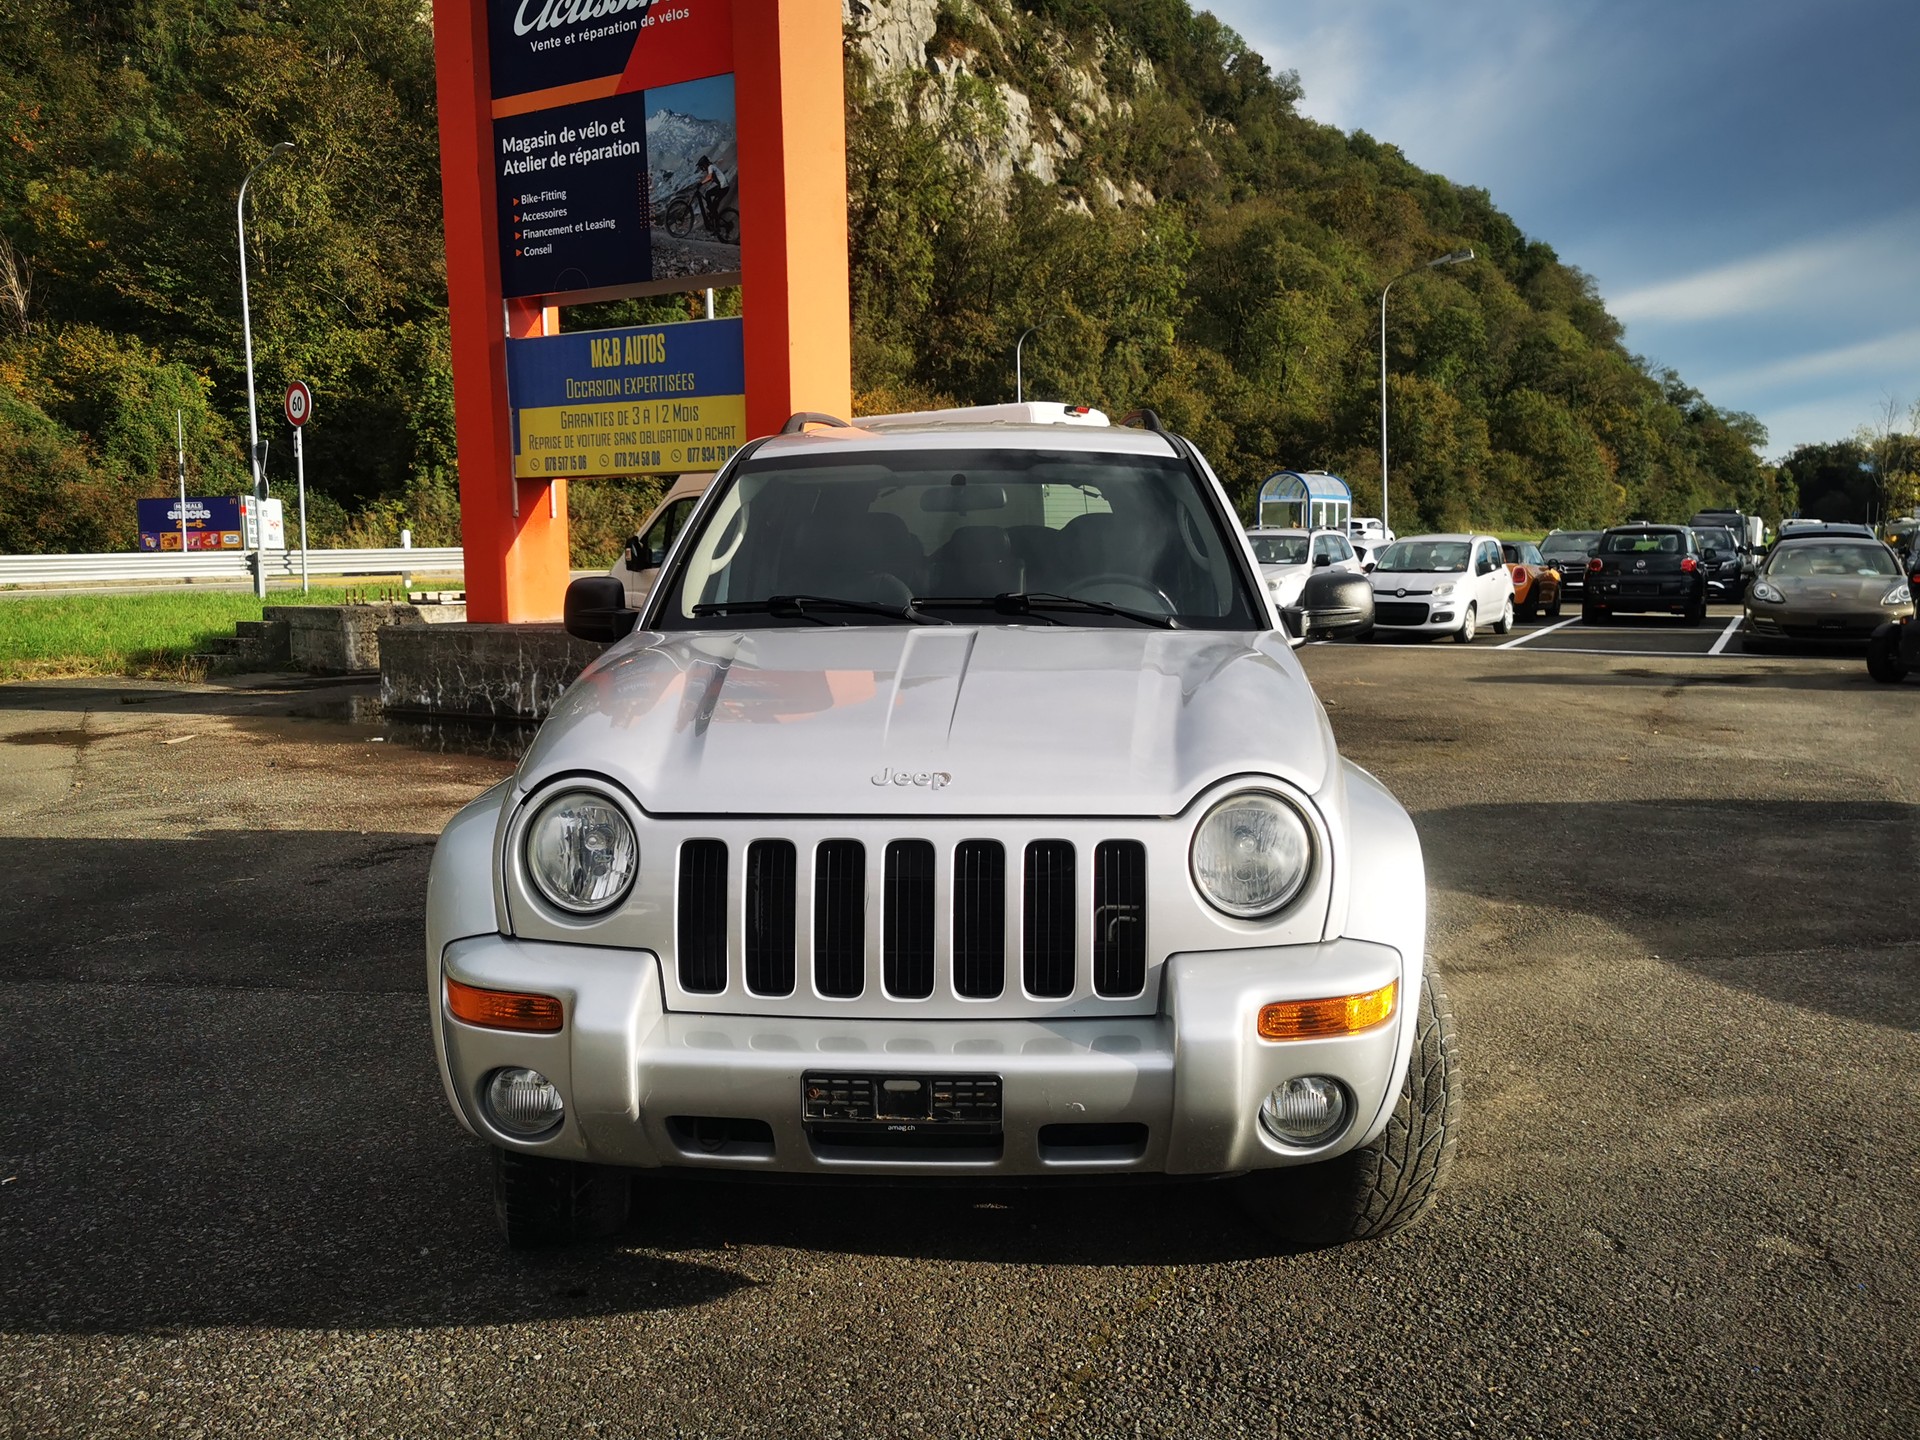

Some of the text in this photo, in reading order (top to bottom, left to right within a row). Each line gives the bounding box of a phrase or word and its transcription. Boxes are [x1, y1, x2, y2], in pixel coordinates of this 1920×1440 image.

[530, 8, 690, 52] Vente et réparation de vélos
[502, 117, 625, 154] Magasin de vélo et
[503, 140, 640, 176] Atelier de réparation
[521, 189, 567, 205] Bike-Fitting
[522, 208, 568, 223] Accessoires
[522, 218, 616, 240] Financement et Leasing
[523, 243, 553, 257] Conseil
[590, 333, 666, 368] M&B AUTOS
[624, 371, 695, 395] EXPERTISÉES
[292, 396, 303, 412] 60
[560, 409, 614, 430] GARANTIES
[617, 410, 629, 425] DE
[632, 406, 640, 425] 3
[564, 435, 574, 448] DE
[577, 433, 611, 448] VOITURE
[614, 431, 637, 446] SANS
[640, 427, 693, 445] OBLIGATION
[687, 446, 700, 463] 077
[871, 767, 952, 791] Jeep
[888, 1124, 915, 1132] amag.ch
